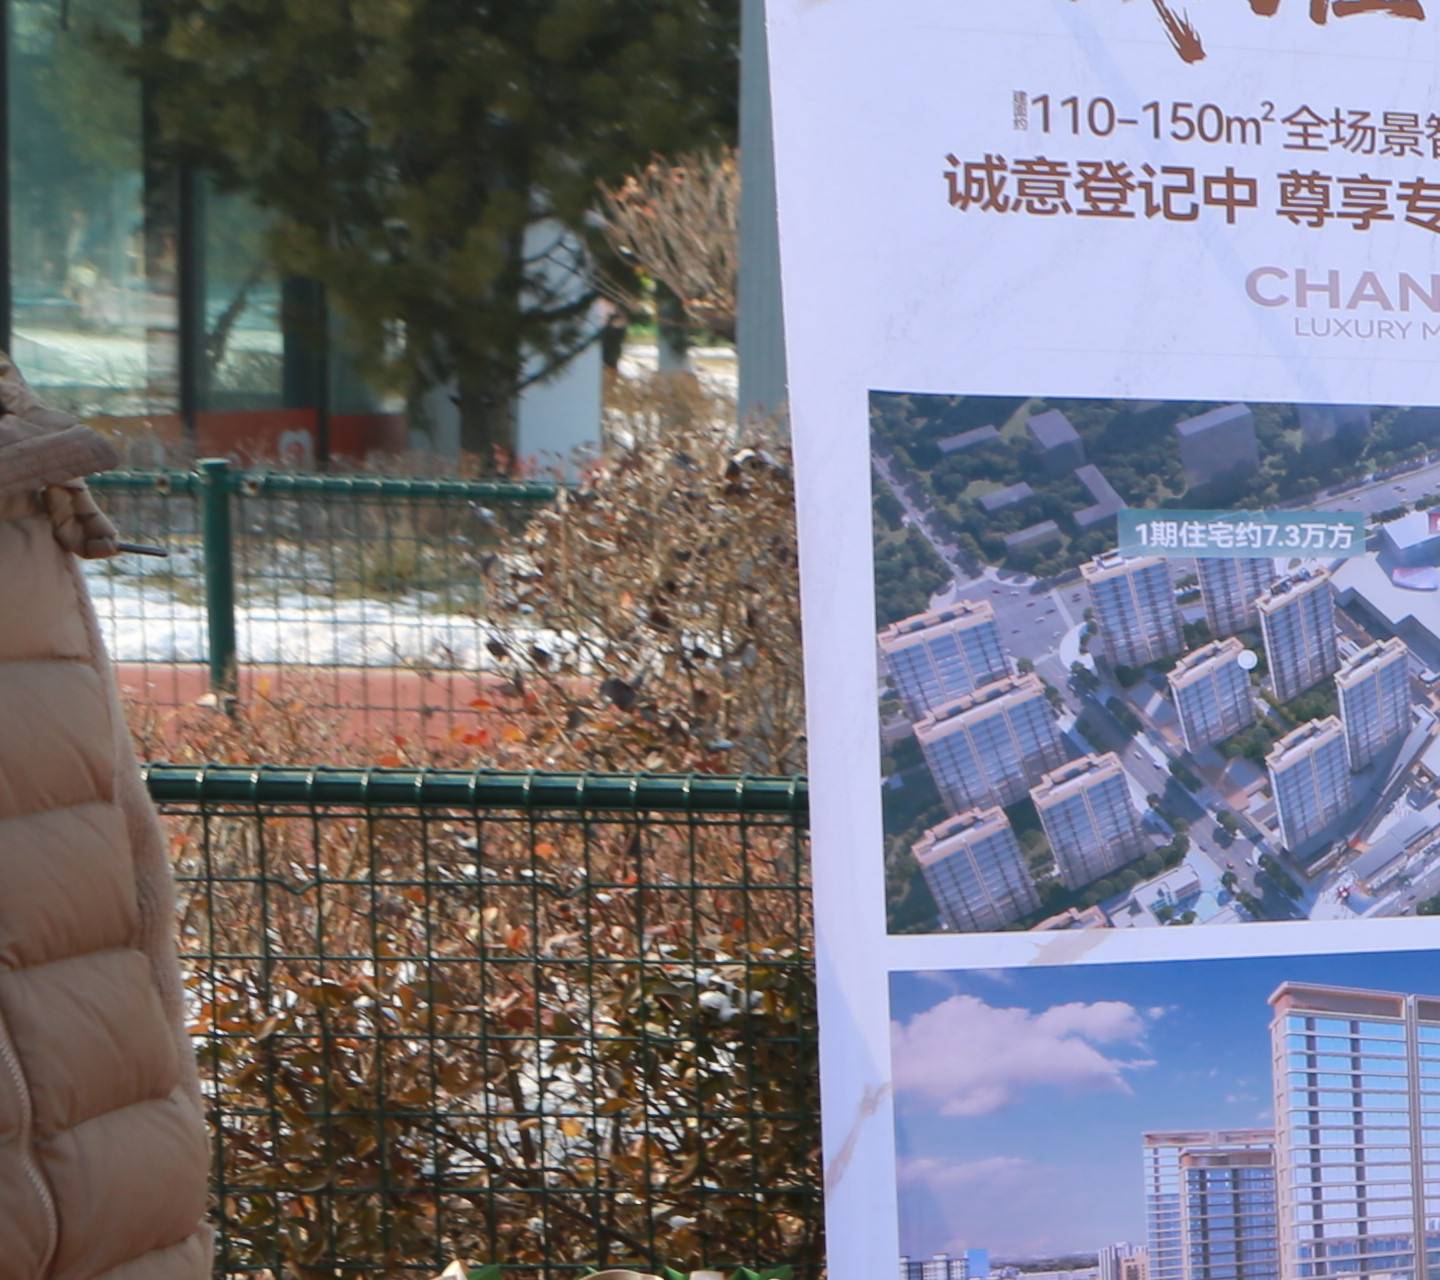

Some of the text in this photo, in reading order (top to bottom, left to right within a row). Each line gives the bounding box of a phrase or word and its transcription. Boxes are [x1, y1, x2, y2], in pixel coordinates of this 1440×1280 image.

[943, 152, 1259, 225] 诚意登记中
[1293, 316, 1411, 341] LUXURY
[1133, 521, 1356, 553] 1期住宅约7.3万方
